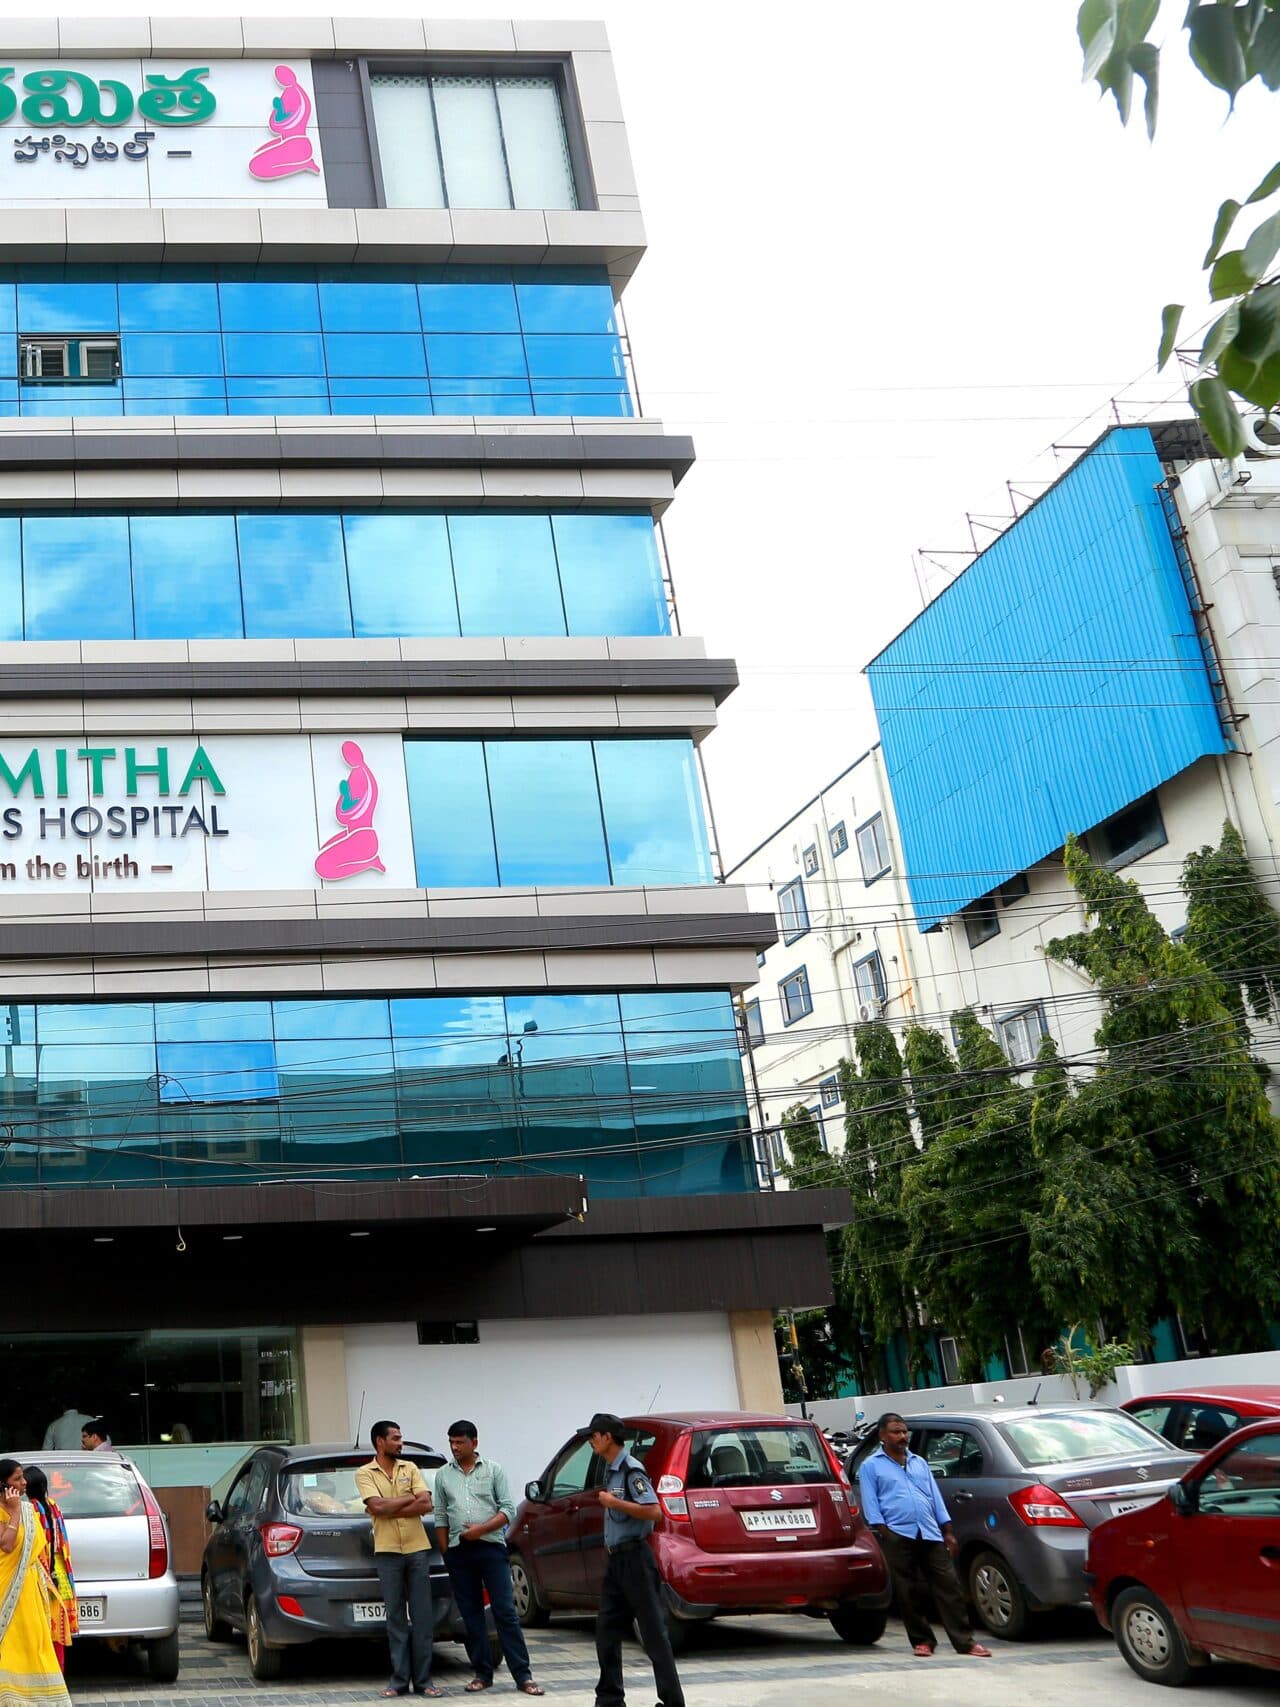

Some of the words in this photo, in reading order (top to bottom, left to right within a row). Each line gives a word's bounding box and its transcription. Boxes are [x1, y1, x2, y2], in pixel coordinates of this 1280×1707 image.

[39, 805, 230, 841] HOSPITAL
[26, 856, 67, 881] the
[76, 854, 140, 880] birth
[361, 1605, 387, 1617] TS07
